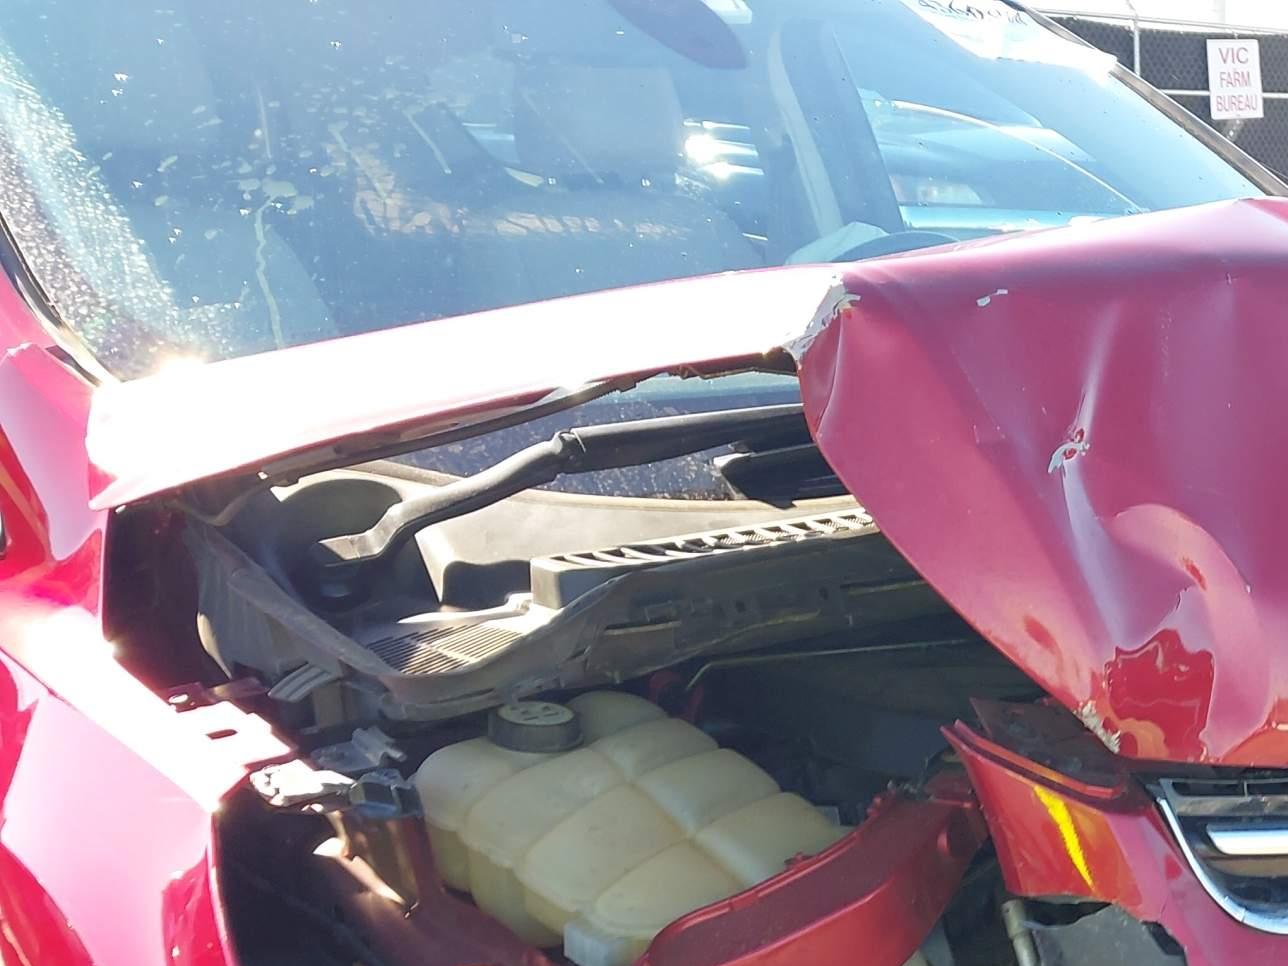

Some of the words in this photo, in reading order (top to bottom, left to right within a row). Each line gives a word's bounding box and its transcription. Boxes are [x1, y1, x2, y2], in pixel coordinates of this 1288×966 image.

[1218, 46, 1249, 64] VIC
[1219, 71, 1252, 88] FARM
[1216, 94, 1258, 112] BUREAU
